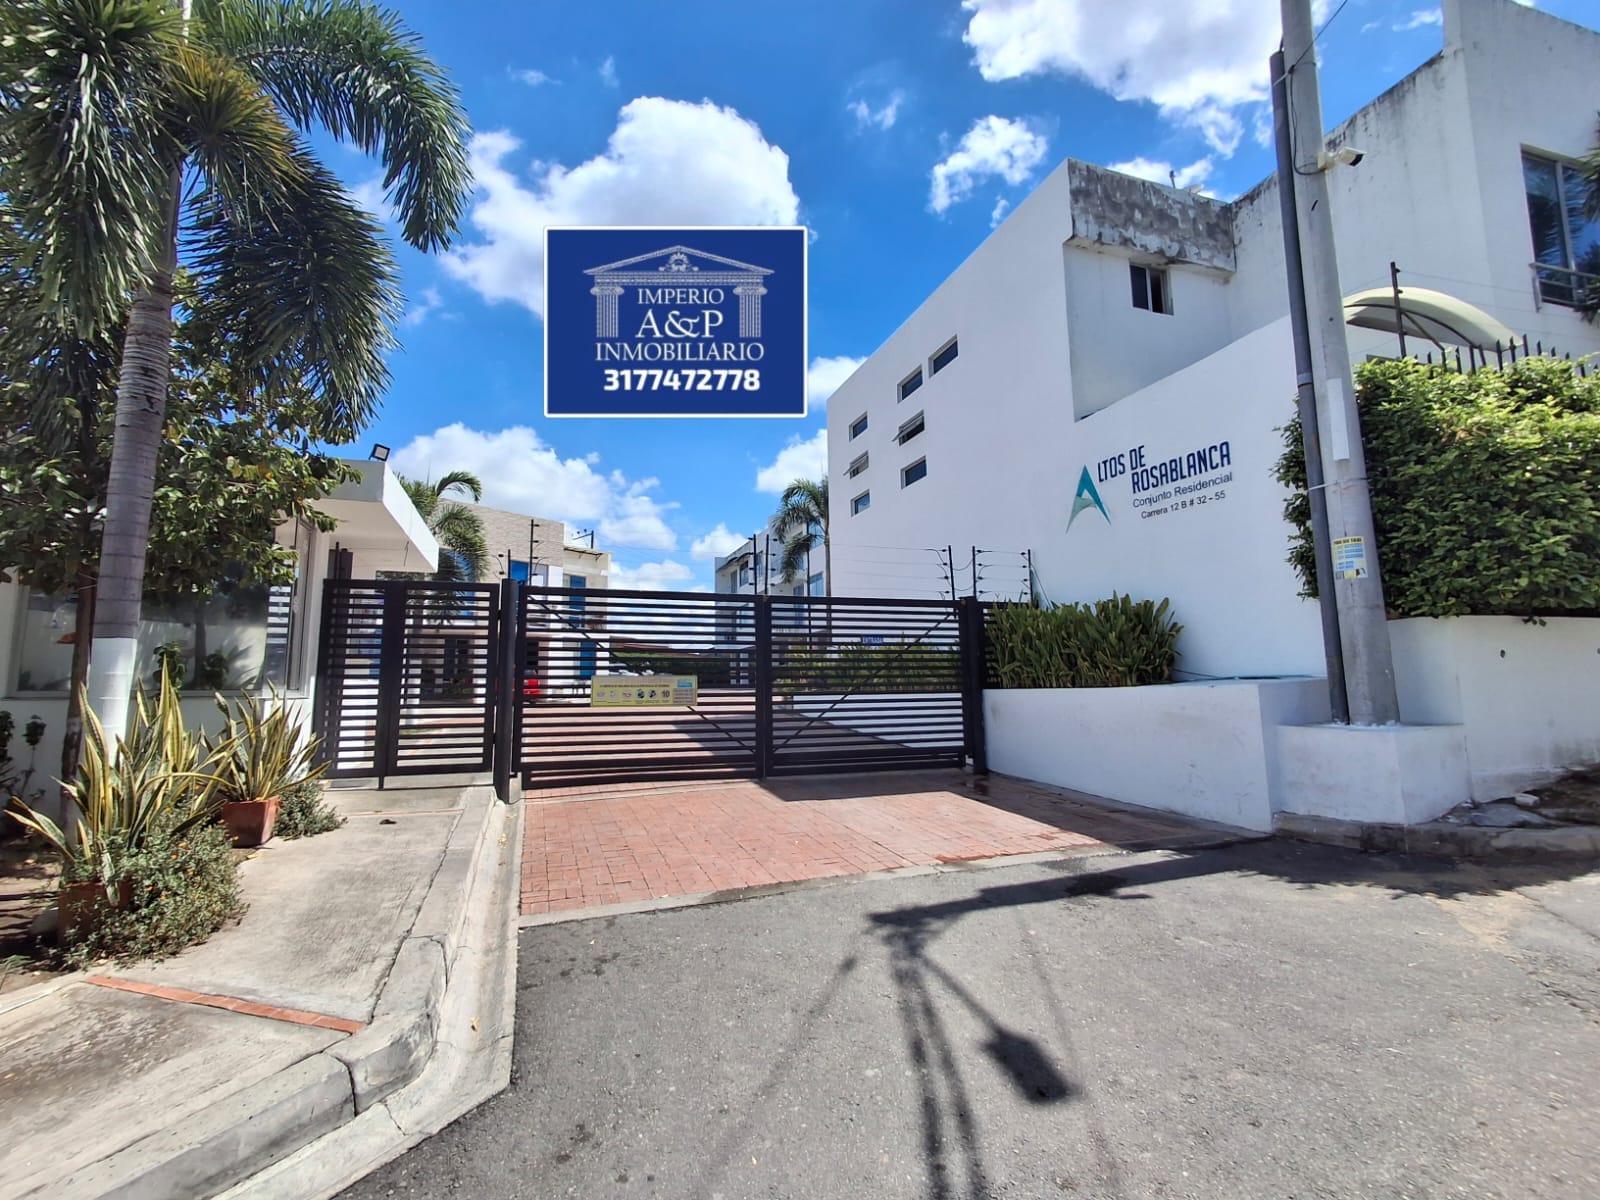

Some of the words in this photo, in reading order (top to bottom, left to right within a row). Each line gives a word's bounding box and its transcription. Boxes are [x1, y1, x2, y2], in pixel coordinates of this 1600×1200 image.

[1129, 445, 1146, 470] DE
[1131, 441, 1231, 494] ROSABLANCA
[1132, 491, 1172, 508] Conjunto
[1174, 472, 1233, 497] Residencial
[1141, 507, 1168, 519] Carrera
[1170, 502, 1180, 512] 12
[1181, 500, 1187, 509] B
[1189, 499, 1195, 507] #
[1196, 495, 1207, 505] 32
[1215, 490, 1226, 500] 55
[662, 690, 670, 698] 10
